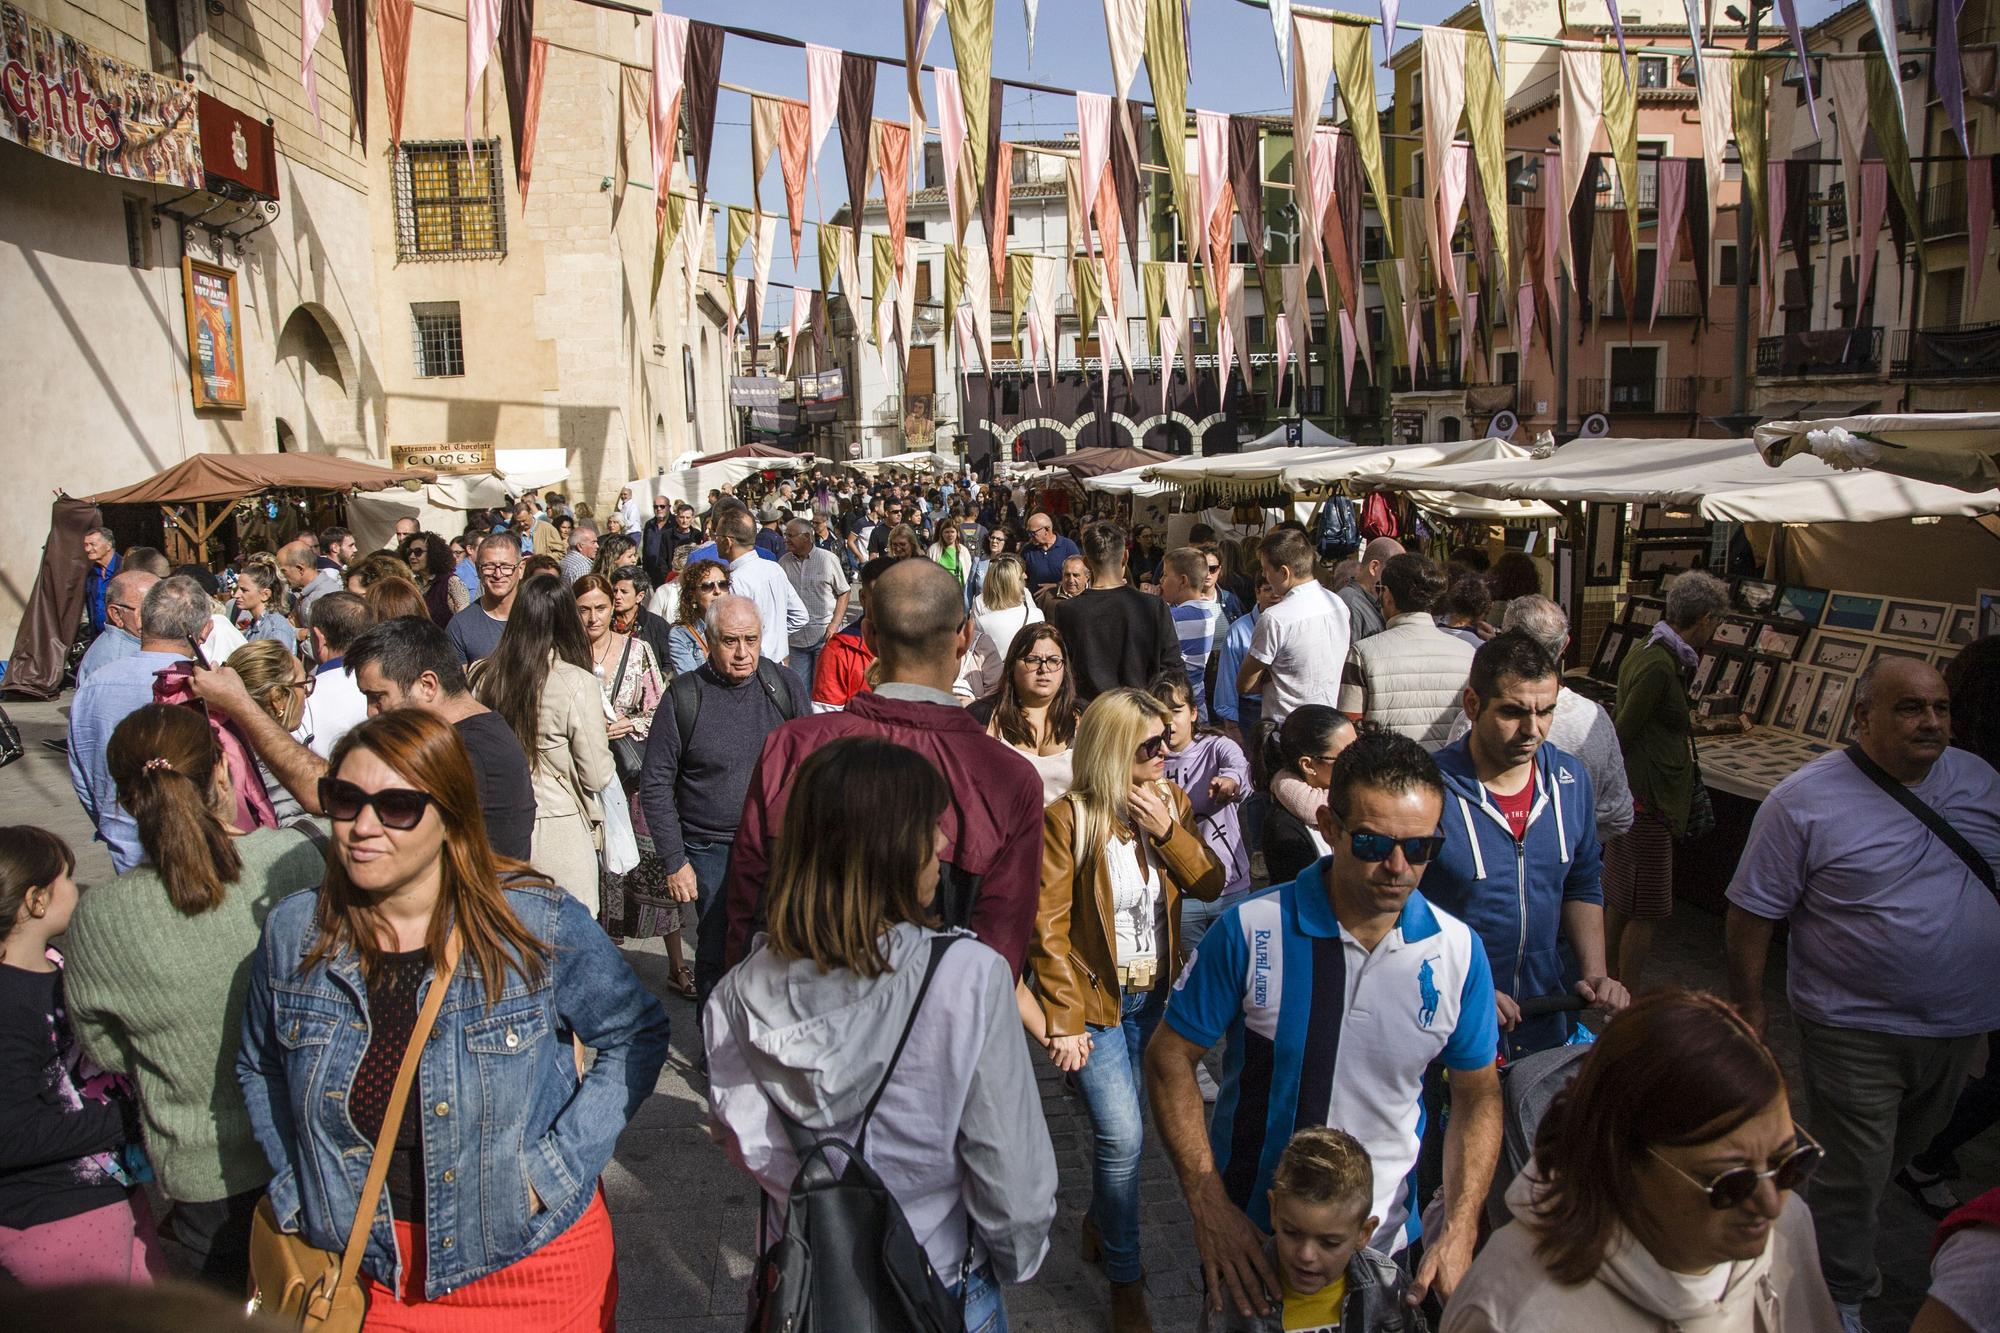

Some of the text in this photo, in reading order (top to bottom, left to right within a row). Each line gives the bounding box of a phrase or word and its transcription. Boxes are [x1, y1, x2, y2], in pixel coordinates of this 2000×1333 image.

[1289, 428, 1297, 439] P
[440, 443, 451, 451] del
[1511, 810, 1524, 818] THE
